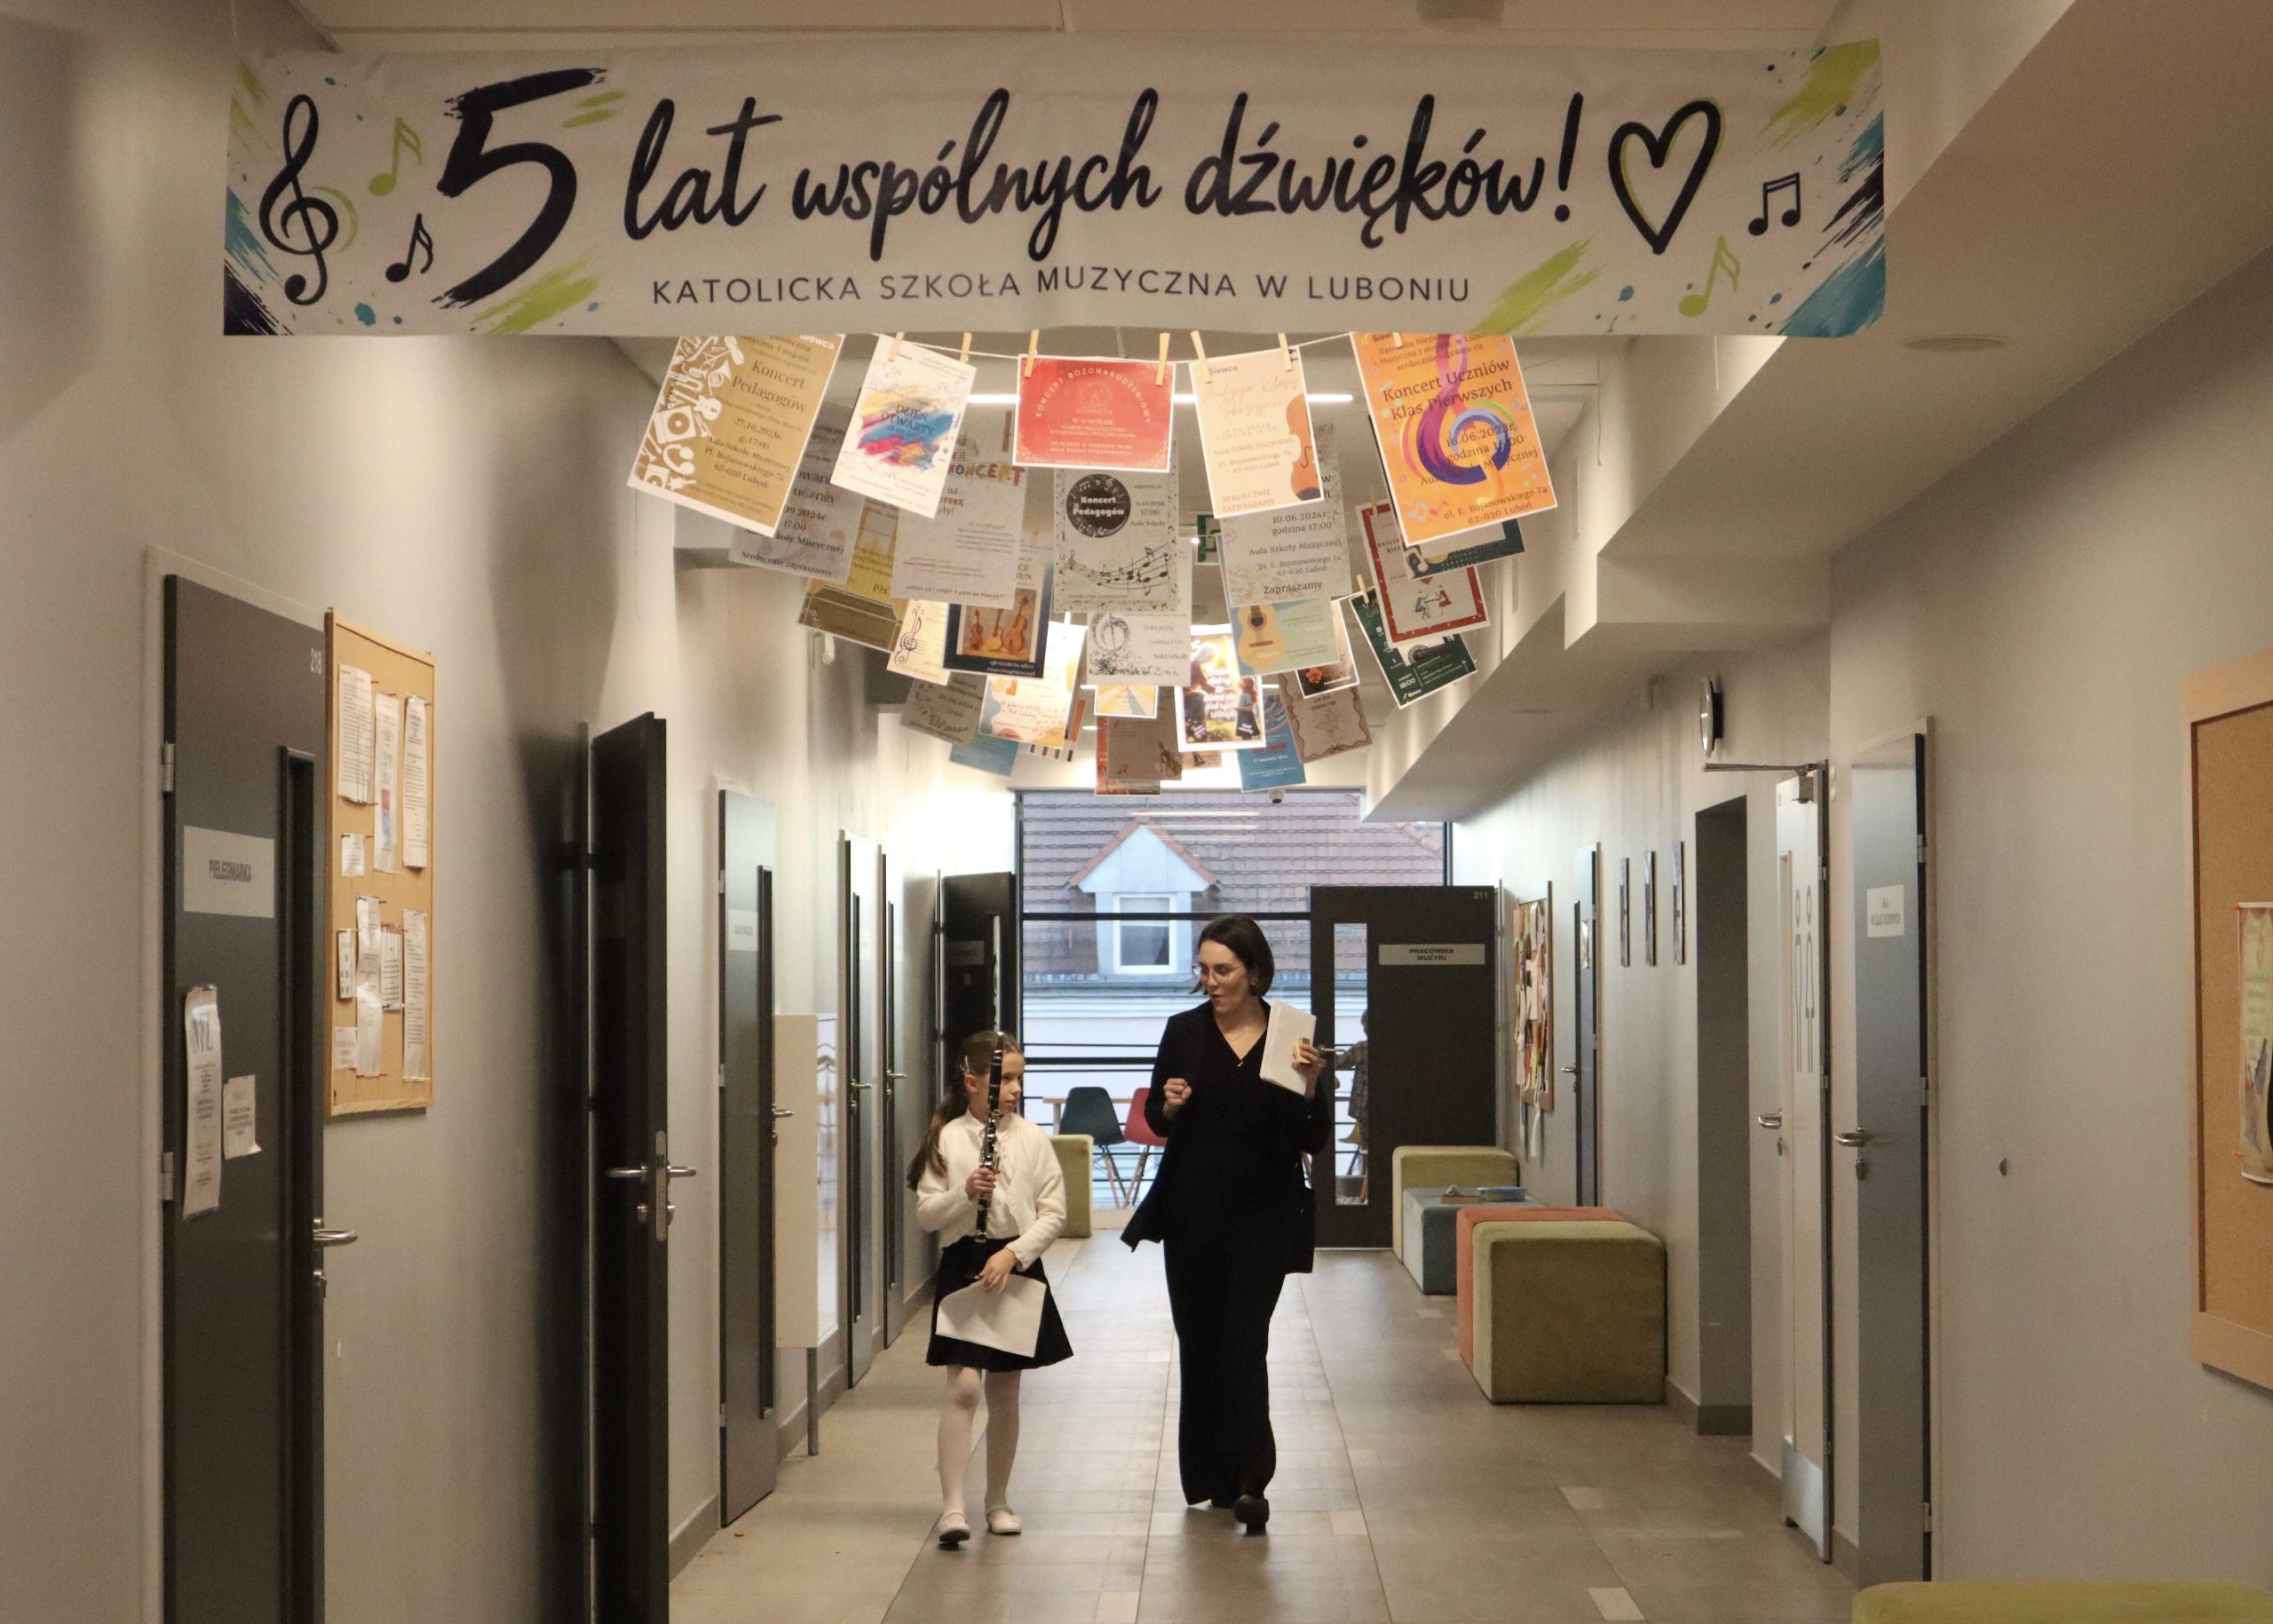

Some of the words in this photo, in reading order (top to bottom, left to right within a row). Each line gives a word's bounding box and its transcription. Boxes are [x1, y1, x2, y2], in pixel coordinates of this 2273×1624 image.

[432, 67, 608, 309] 5
[624, 97, 783, 240] lat
[792, 88, 1162, 261] wspólnych
[1184, 91, 1584, 249] dźwięków!
[653, 278, 860, 304] KATOLICKA
[880, 273, 1020, 299] SZKOŁA
[1037, 266, 1236, 297] MUZYCZNA
[1256, 275, 1287, 298] W
[1308, 276, 1469, 302] LUBONIU
[1379, 351, 1416, 365] Muzyczna
[752, 360, 805, 390] Koncert
[1208, 366, 1238, 376] Siewca
[1383, 376, 1442, 401] Koncert
[1446, 360, 1510, 384] Uczniów
[733, 375, 808, 412] Pedagogów
[1035, 377, 1064, 418] KONCERT
[1067, 368, 1151, 424] BOŻONARODZENIOWY
[1391, 405, 1423, 420] Klas
[1428, 378, 1513, 410] Pierwszych
[896, 404, 928, 422] DZIEŃ
[881, 411, 934, 436] OTWARTY
[1232, 444, 1254, 454] Szkoły
[1255, 438, 1294, 450] Muzycznej
[1447, 447, 1490, 463] godzina
[717, 450, 773, 478] Bojanowskiego
[753, 451, 790, 471] Muzycznej
[742, 473, 768, 488] Luboń
[1222, 498, 1275, 512] ZAPRASZAMY
[1223, 489, 1271, 503] SERDECZNIE
[1444, 511, 1455, 519] pl.
[1469, 491, 1535, 513] Bojanowskiego
[1073, 508, 1124, 517] Pedagogów
[1468, 511, 1501, 525] 62-030
[1505, 502, 1532, 515] Luboń
[1271, 526, 1306, 536] godzina
[1309, 521, 1332, 531] 17:00
[797, 536, 844, 555] Muzycznej
[1249, 546, 1267, 556] Aula
[1270, 543, 1297, 554] Szkoły
[1299, 539, 1342, 551] Muzycznej
[741, 551, 783, 566] Serdecznie
[786, 560, 833, 576] zapraszamy
[1279, 556, 1330, 568] Bojanowskiego
[1306, 565, 1327, 574] Luboń
[1263, 582, 1323, 595] Zapraszamy
[310, 648, 322, 676] 218
[1473, 891, 1488, 899] 211
